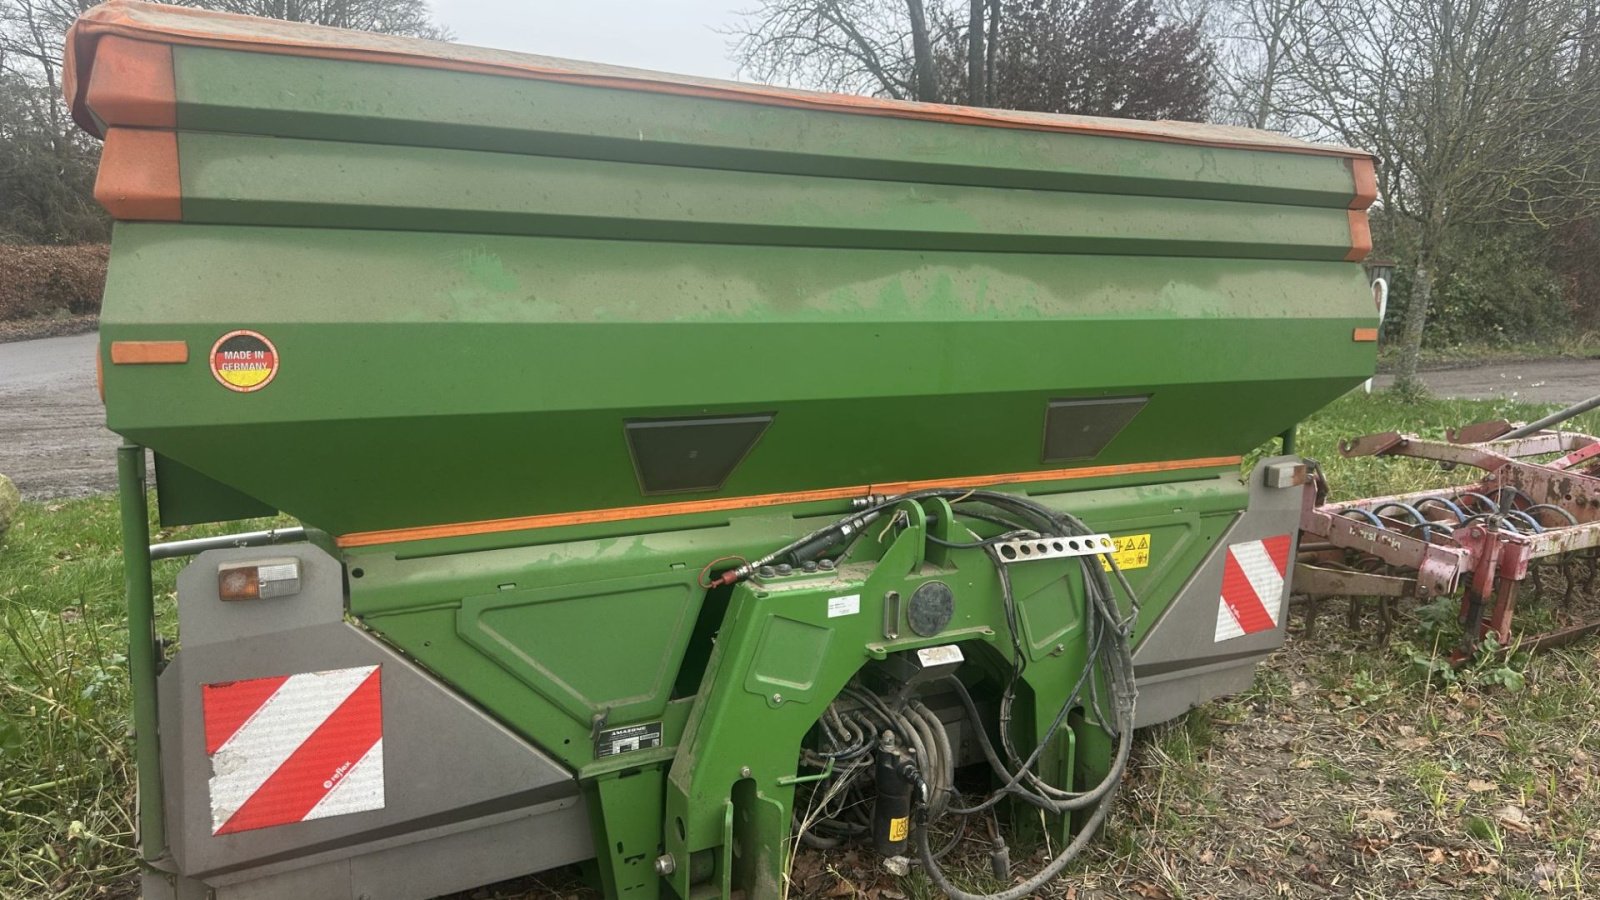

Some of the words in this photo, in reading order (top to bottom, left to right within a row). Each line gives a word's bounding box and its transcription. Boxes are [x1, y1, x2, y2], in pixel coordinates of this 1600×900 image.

[224, 351, 252, 360] MADE
[254, 350, 264, 359] IN
[221, 362, 268, 372] GERMANY
[331, 760, 352, 782] reflex
